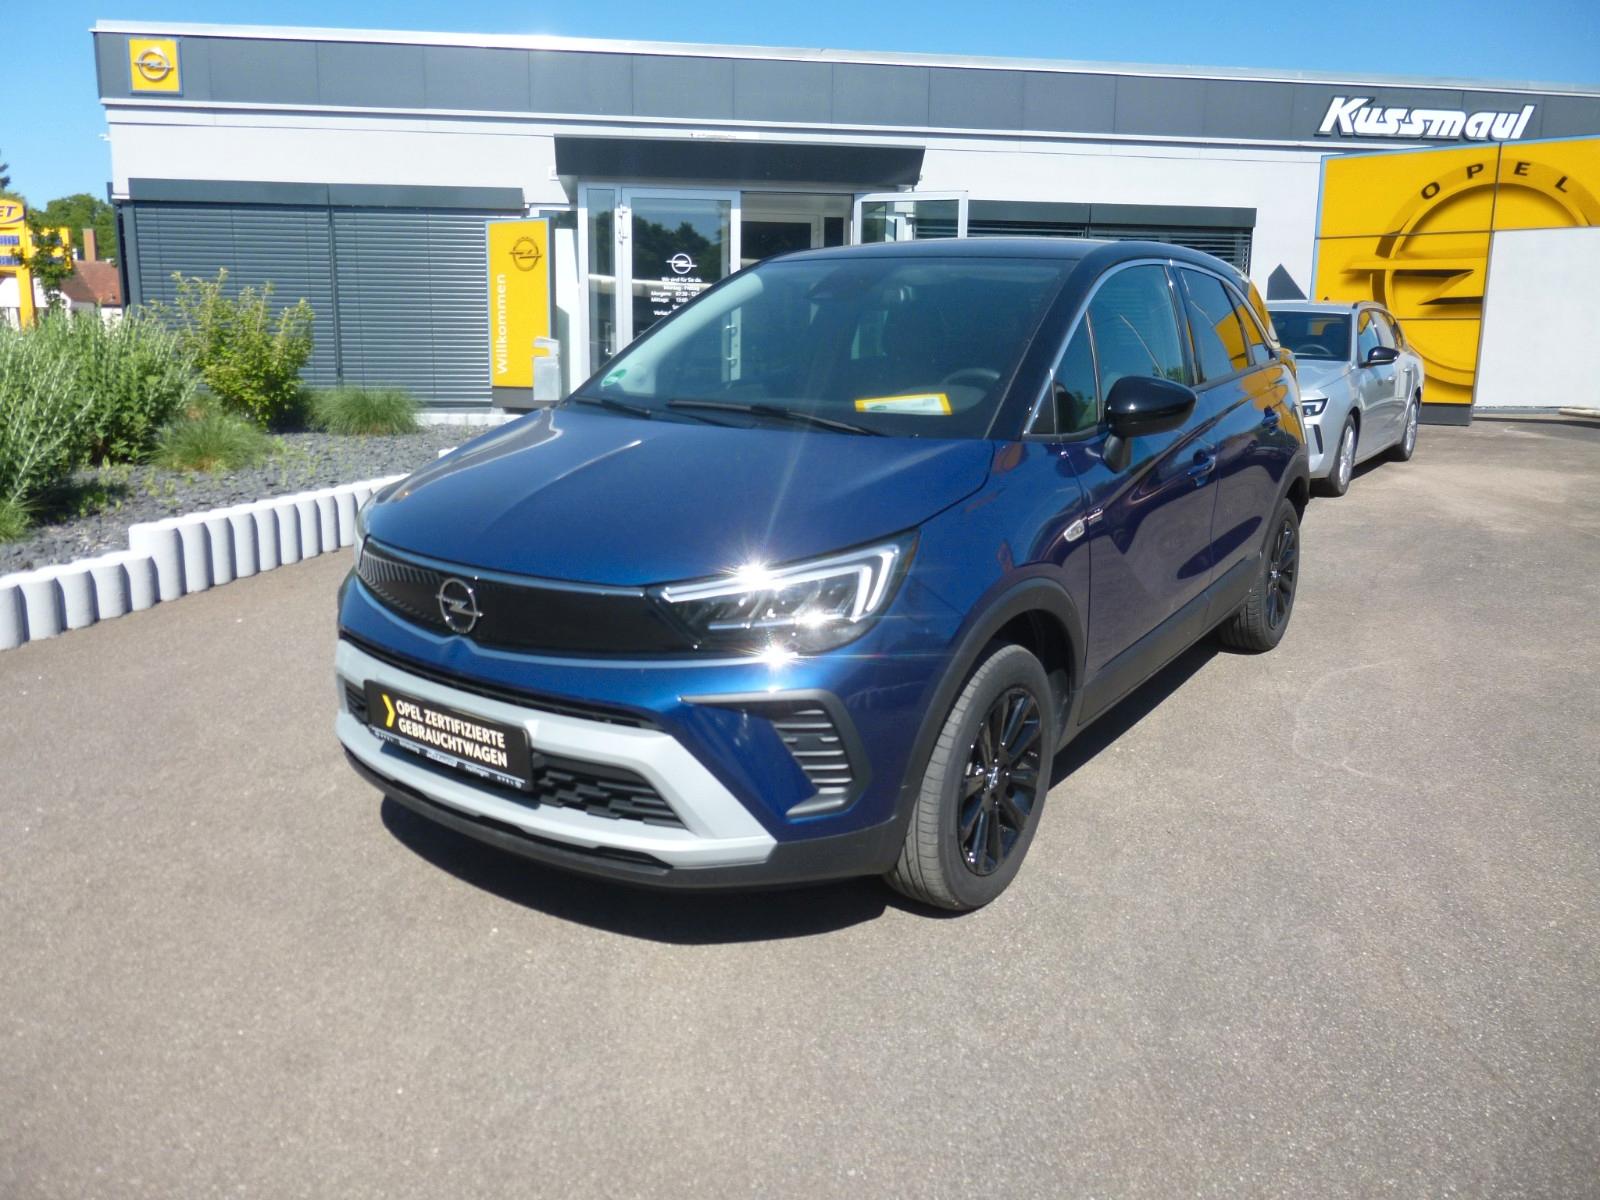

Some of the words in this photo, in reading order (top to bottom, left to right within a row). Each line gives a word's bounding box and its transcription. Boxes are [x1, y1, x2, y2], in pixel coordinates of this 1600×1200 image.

[1317, 96, 1536, 140] Kussmaul
[1421, 161, 1568, 200] OPEL
[496, 274, 508, 375] Willkommen
[395, 700, 423, 722] OPEL
[423, 709, 506, 749] ZERTIFIZIERTE
[398, 718, 508, 768] GEBRAUCHTWAGEN
